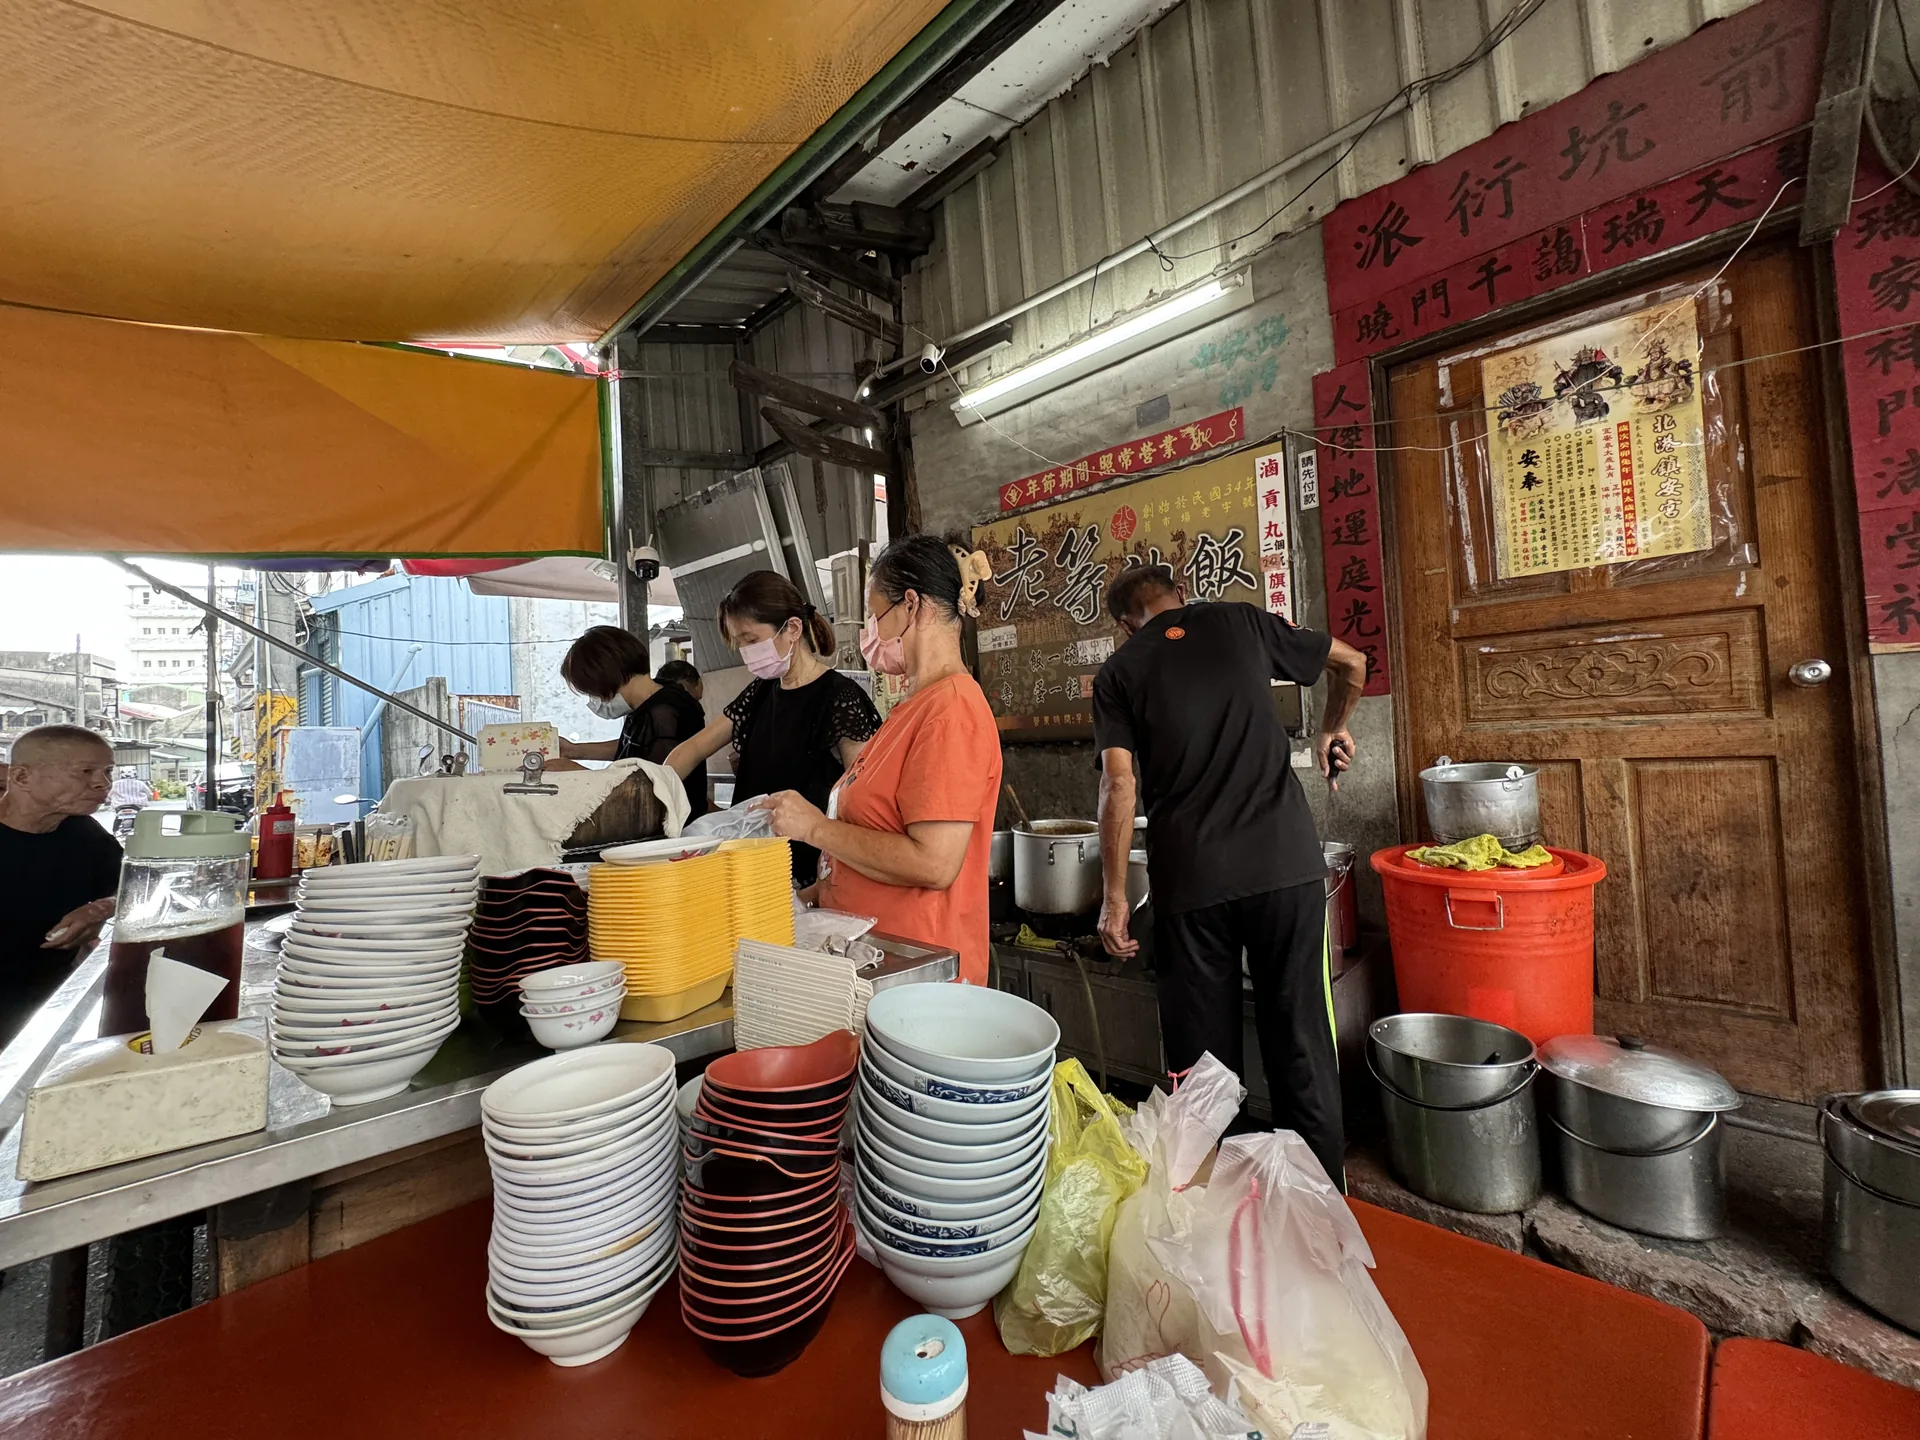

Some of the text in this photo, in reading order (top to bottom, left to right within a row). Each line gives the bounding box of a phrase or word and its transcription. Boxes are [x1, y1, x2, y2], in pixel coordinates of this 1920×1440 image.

[1301, 455, 1316, 506] 請先付款
[1517, 449, 1545, 491] 安奉
[1651, 414, 1684, 519] 北港鎮安宮
[1111, 504, 1135, 539] 北港
[1260, 458, 1284, 541] 滷貢丸
